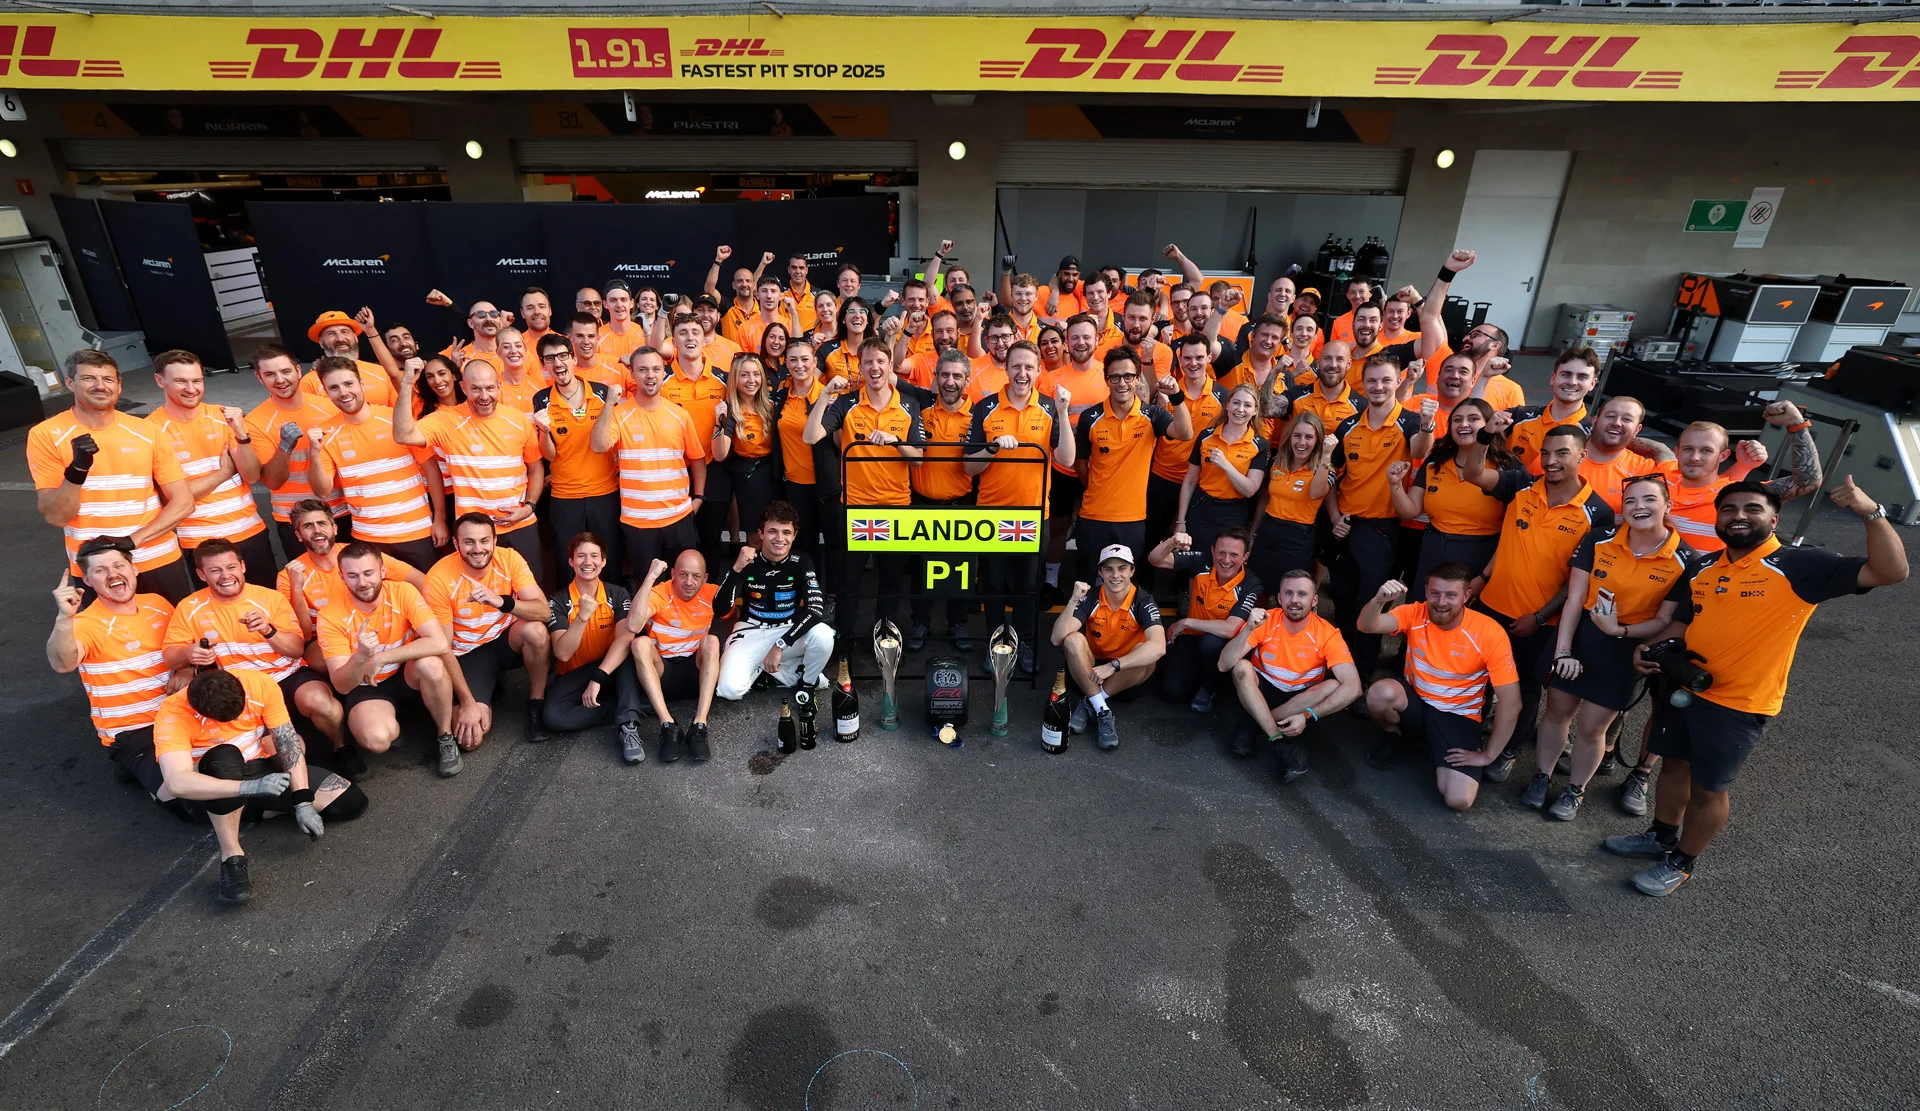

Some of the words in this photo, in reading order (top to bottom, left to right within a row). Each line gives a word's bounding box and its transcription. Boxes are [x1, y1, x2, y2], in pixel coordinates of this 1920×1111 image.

[0, 26, 80, 77] L
[246, 28, 460, 79] DHL
[576, 38, 666, 68] 1.91s
[695, 39, 770, 57] DHL
[1020, 28, 1243, 81] DHL
[1416, 35, 1640, 88] DHL
[681, 64, 757, 78] FASTEST
[761, 64, 788, 78] PIT
[793, 64, 838, 78] STOP
[842, 64, 885, 78] 2025
[5, 94, 16, 112] 6
[627, 95, 634, 112] 5
[204, 121, 269, 131] NORRIS
[673, 120, 739, 130] PIASTRI
[1183, 118, 1235, 126] McLaren
[645, 190, 701, 199] McLaren
[143, 258, 172, 269] McLaren
[322, 258, 385, 267] McLaren
[496, 258, 548, 266] McLare
[803, 252, 837, 260] cLaren
[613, 263, 670, 271] McLaren
[893, 519, 996, 542] LANDO
[926, 560, 970, 590] P1
